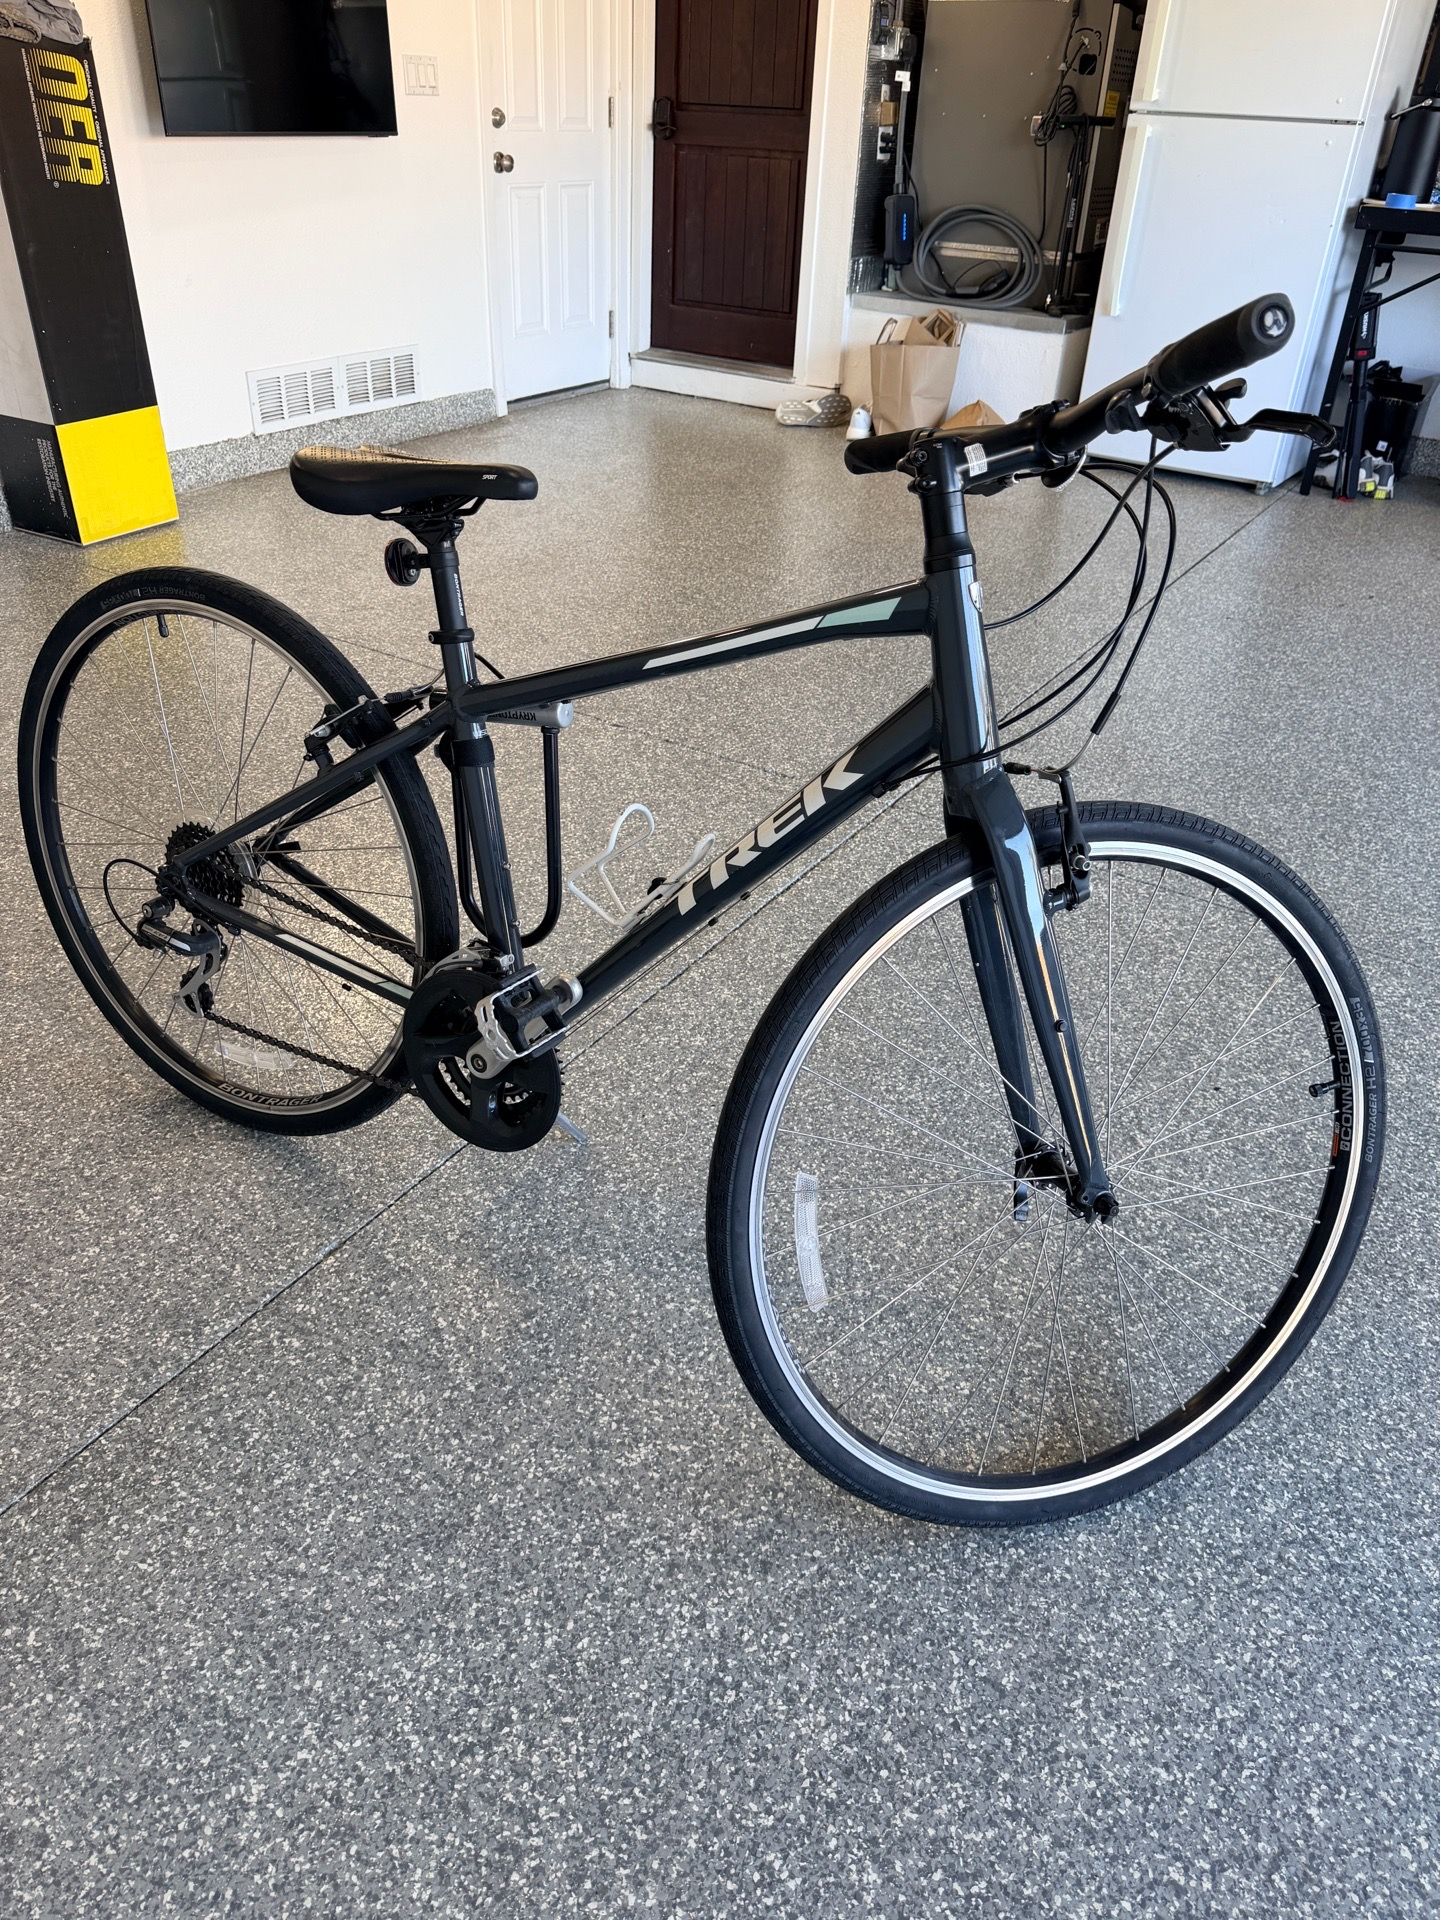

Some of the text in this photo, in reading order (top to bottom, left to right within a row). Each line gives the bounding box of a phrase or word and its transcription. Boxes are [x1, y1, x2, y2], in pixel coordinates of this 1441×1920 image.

[21, 48, 31, 82] MANUFACTURING
[83, 60, 110, 185] ORIGINAL QUALITY ORIGINAL APPEARANCE
[453, 573, 464, 617] BONTRAGER
[490, 711, 537, 721] KRYPTO
[662, 746, 865, 916] TREK
[218, 1082, 323, 1106] BONTRAGER
[1330, 1021, 1353, 1141] CONNECTION
[1365, 1066, 1377, 1090] H2
[1364, 1093, 1378, 1163] BONTRAGER
